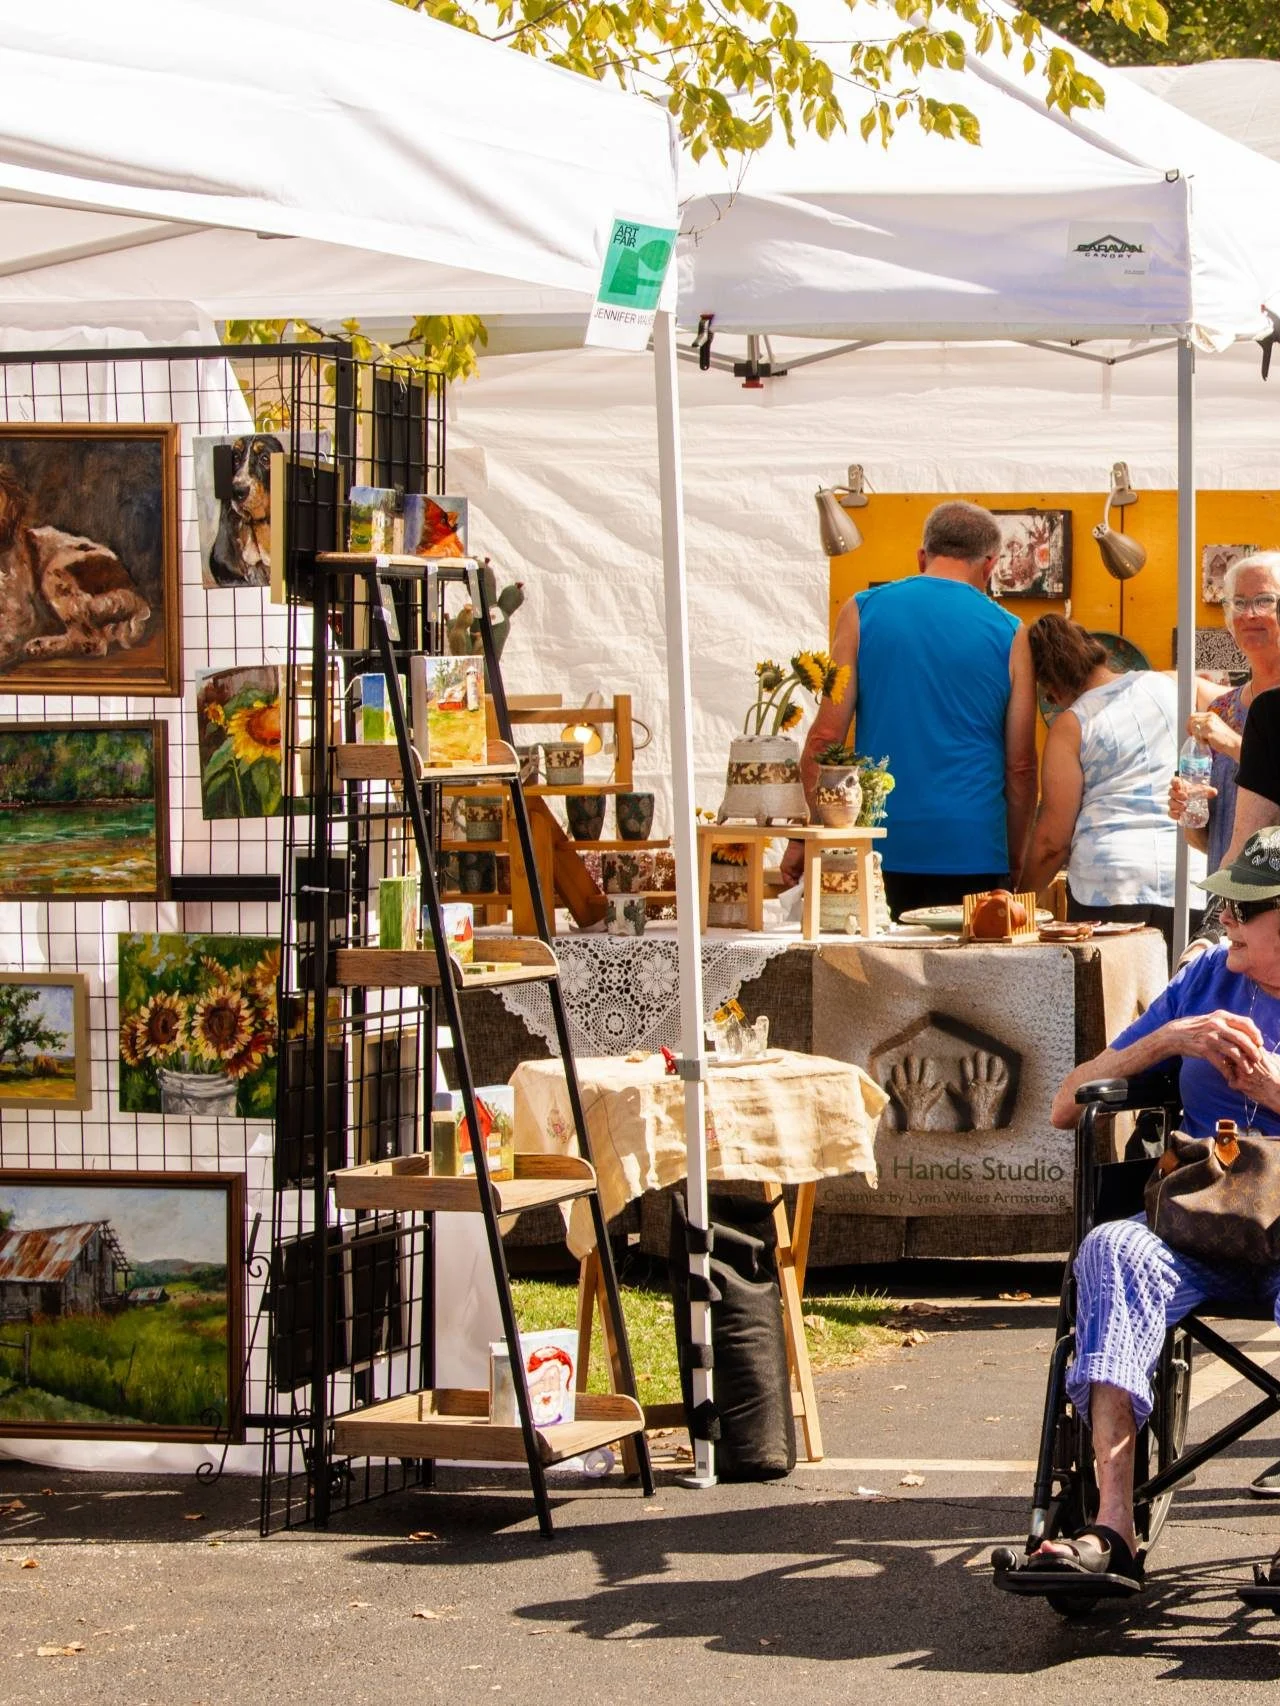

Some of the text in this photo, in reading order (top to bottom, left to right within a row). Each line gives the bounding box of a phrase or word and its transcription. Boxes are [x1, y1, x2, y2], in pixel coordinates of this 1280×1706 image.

[615, 225, 640, 237] ART
[613, 234, 637, 248] FAIR
[1076, 243, 1143, 253] CARAVAN
[594, 307, 637, 324] JENNIFER
[893, 1156, 973, 1181] Hands
[982, 1157, 1065, 1182] Studio
[823, 1188, 1066, 1208] Ceramics by Lynn Wilkes Armstrong
